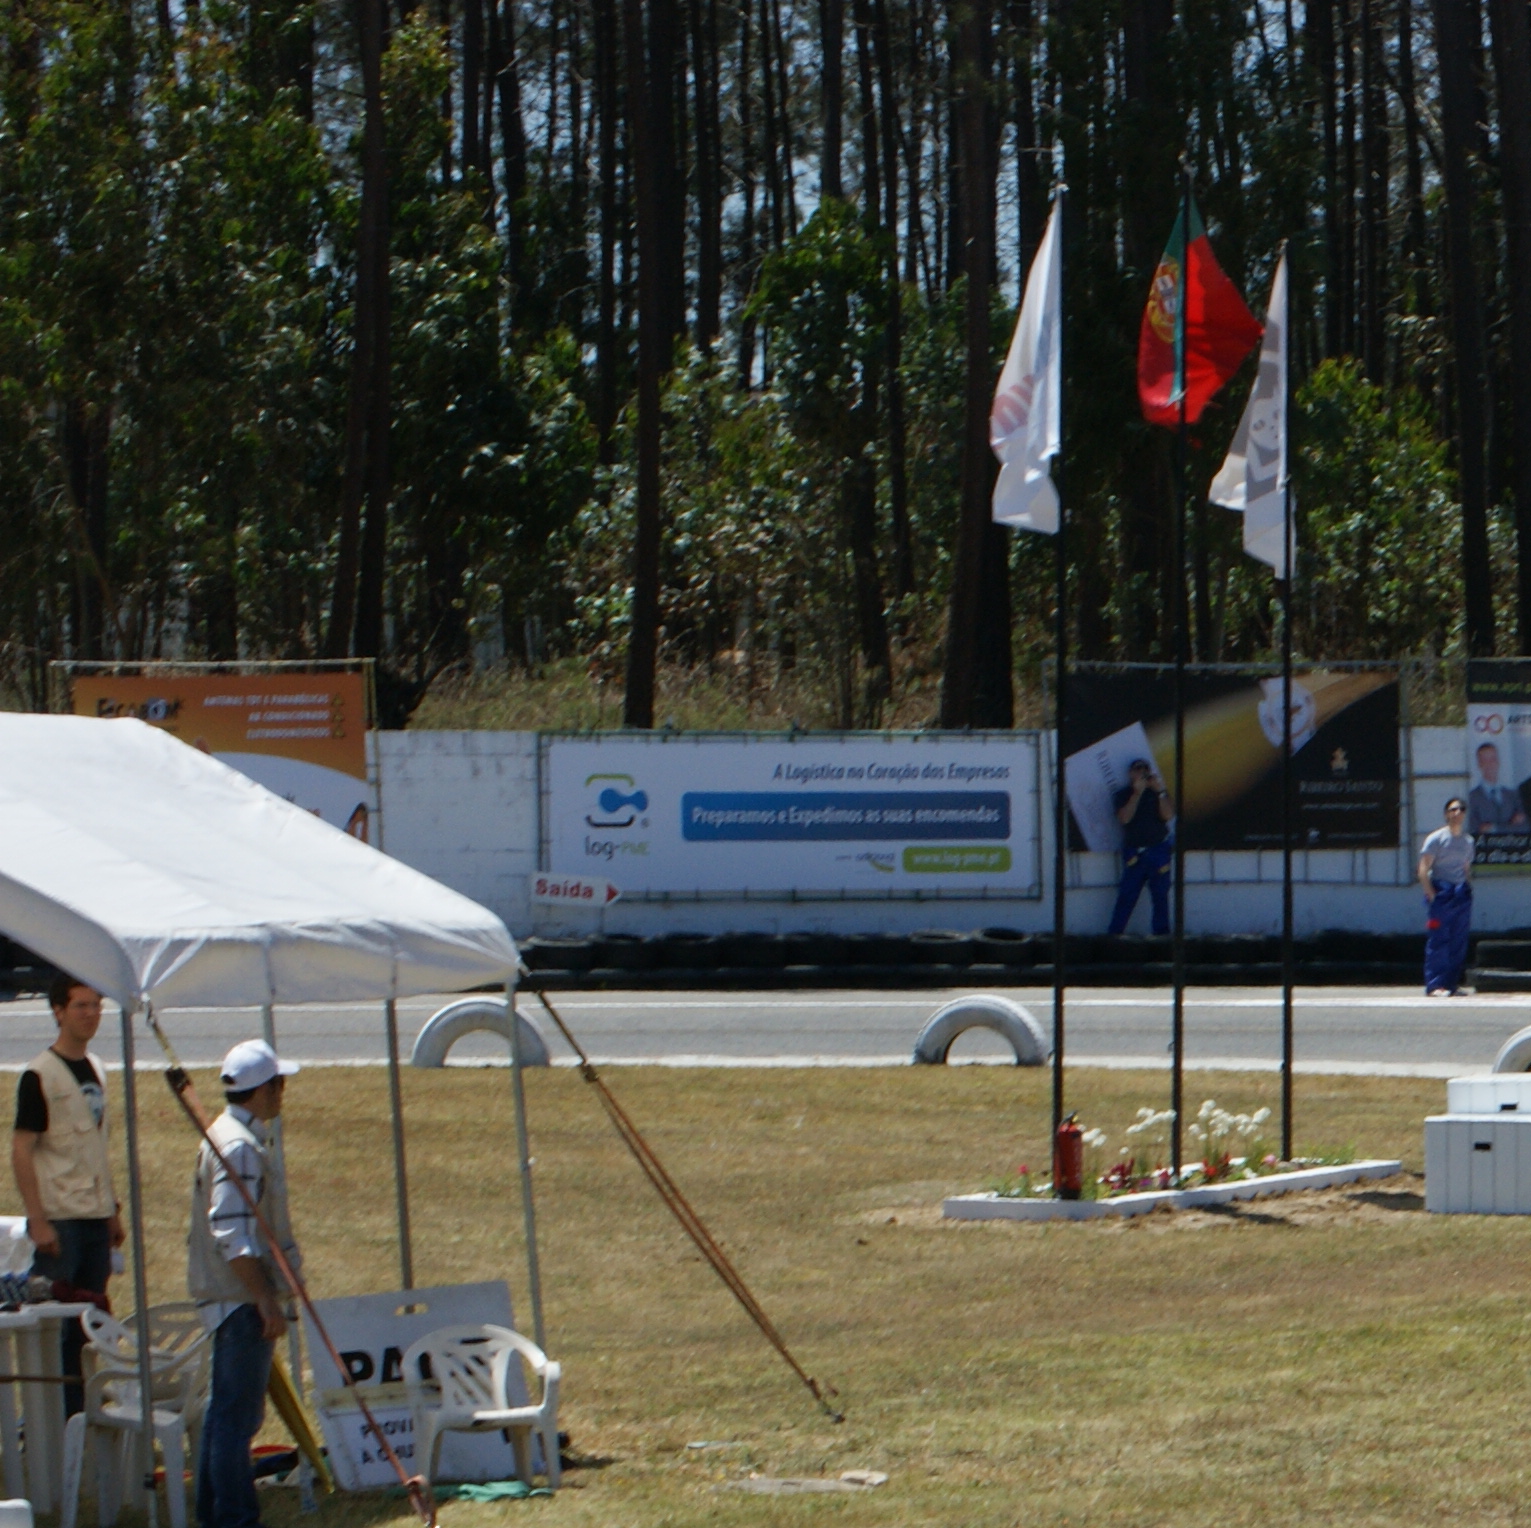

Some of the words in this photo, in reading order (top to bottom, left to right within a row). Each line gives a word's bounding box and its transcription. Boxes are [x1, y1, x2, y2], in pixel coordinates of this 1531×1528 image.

[772, 764, 784, 780] A
[866, 763, 919, 783] Coração
[946, 763, 1010, 783] Empresas
[691, 806, 776, 828] Preparamos
[788, 806, 864, 828] Expedimos
[865, 809, 881, 823] as
[882, 809, 913, 823] suas
[914, 805, 1000, 823] encomendas
[535, 878, 594, 900] Saída
